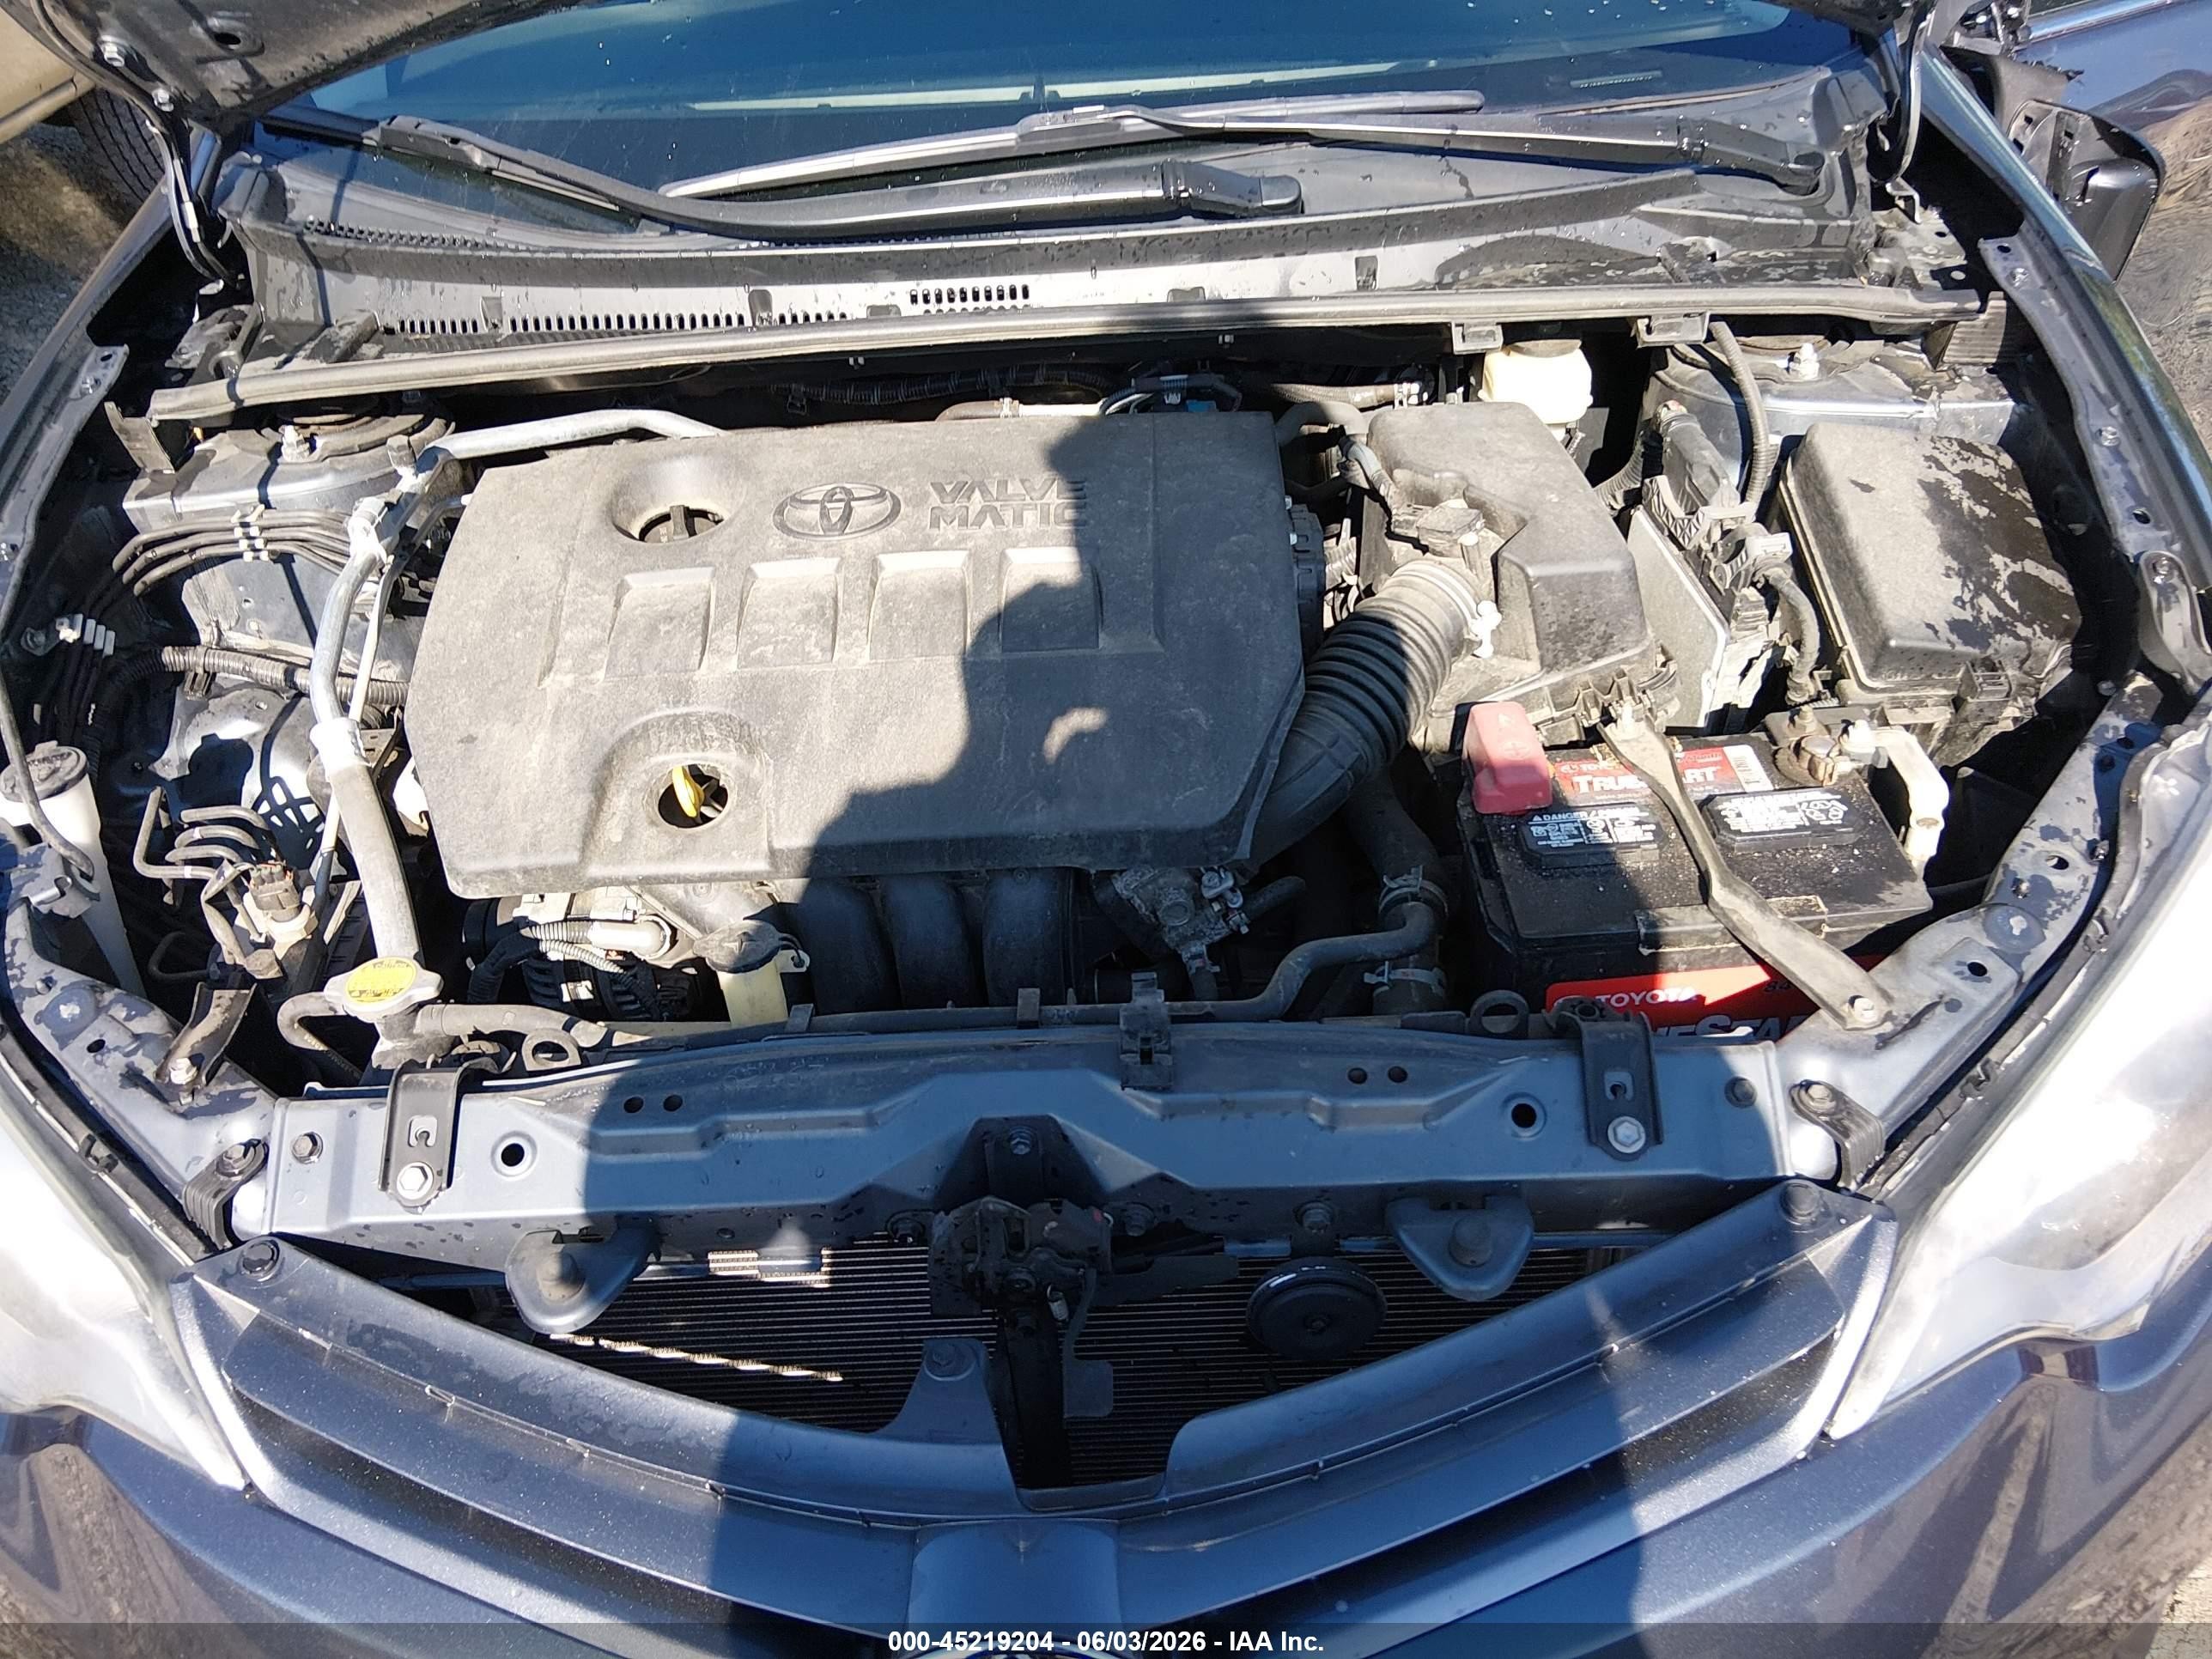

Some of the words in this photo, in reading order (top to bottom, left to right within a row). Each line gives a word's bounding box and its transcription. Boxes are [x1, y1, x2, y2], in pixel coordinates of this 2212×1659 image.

[930, 477, 1087, 504] VALVE
[928, 501, 1087, 530] MATIC
[1595, 986, 1698, 1007] TOYOTA
